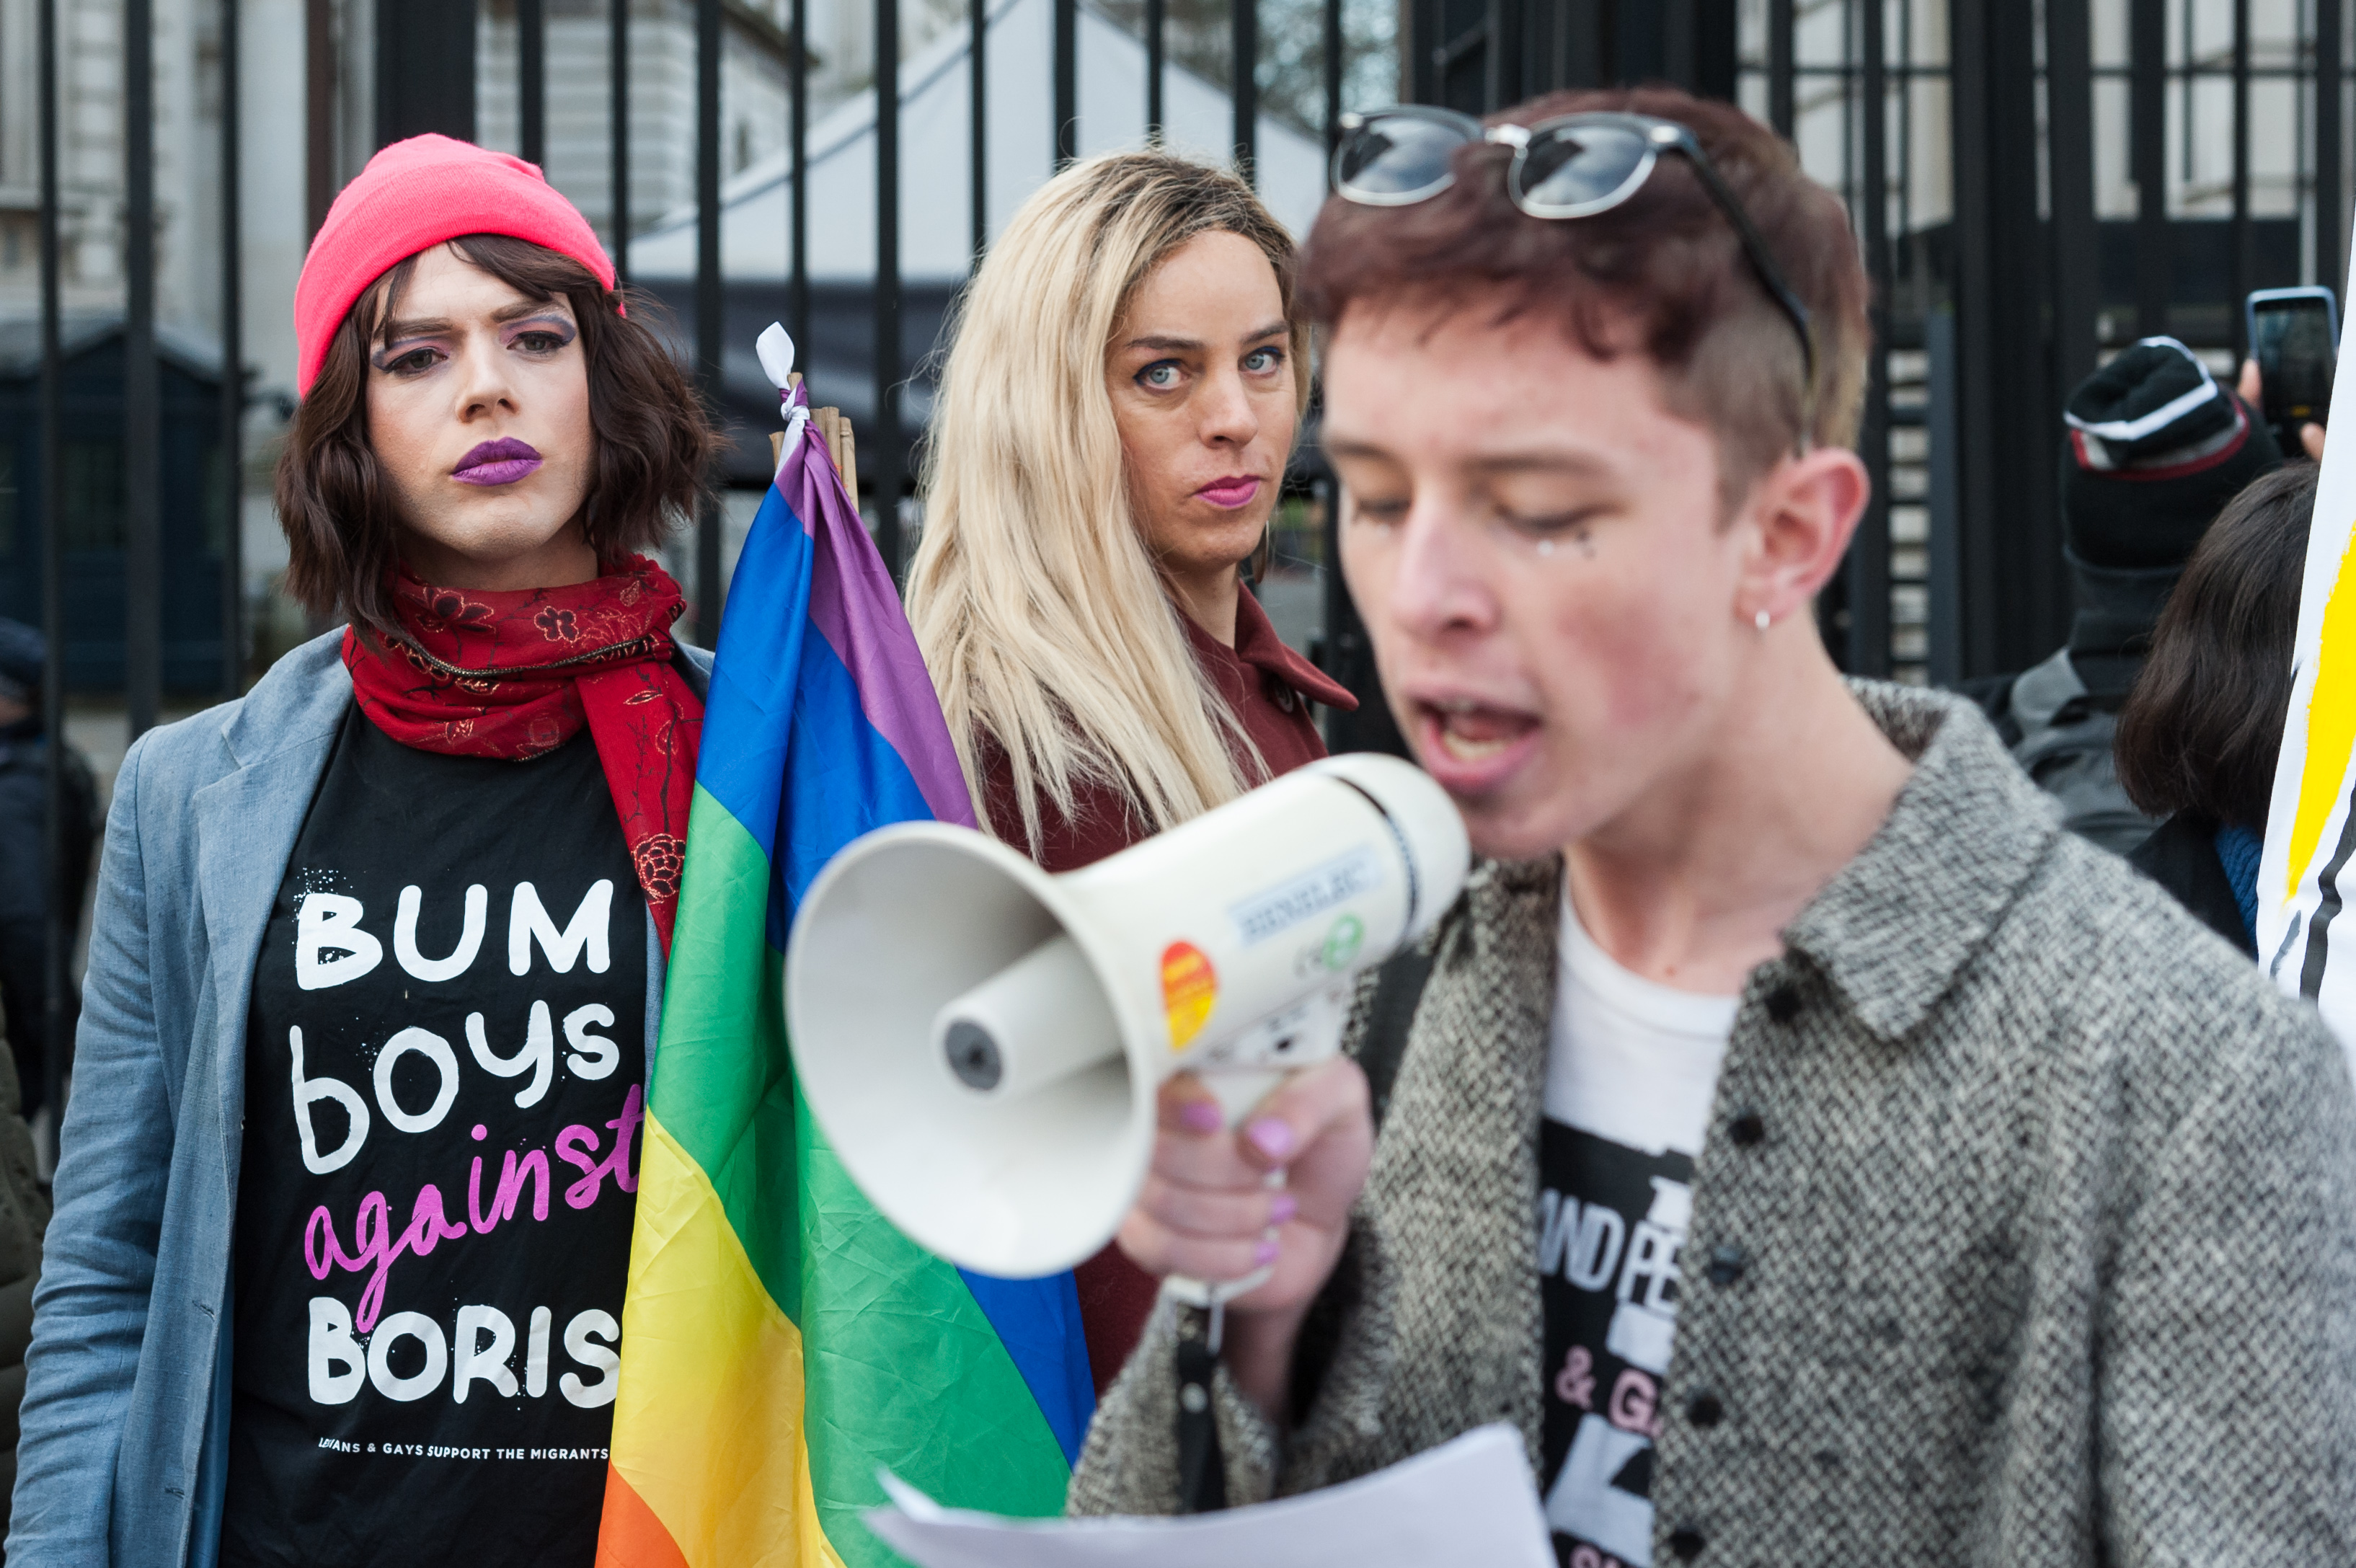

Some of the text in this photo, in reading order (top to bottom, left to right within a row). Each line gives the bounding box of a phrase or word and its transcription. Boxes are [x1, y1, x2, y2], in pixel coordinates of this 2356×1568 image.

[296, 879, 614, 990] BUM
[289, 1000, 619, 1174] boys
[305, 1084, 645, 1333] against
[309, 1297, 621, 1408] BORIS
[1555, 1345, 1665, 1438] & G
[367, 1443, 376, 1453] &
[383, 1443, 423, 1456] GAYS
[427, 1445, 491, 1459] SUPPORT
[496, 1448, 525, 1459] THE
[530, 1448, 608, 1460] MIGRANTS
